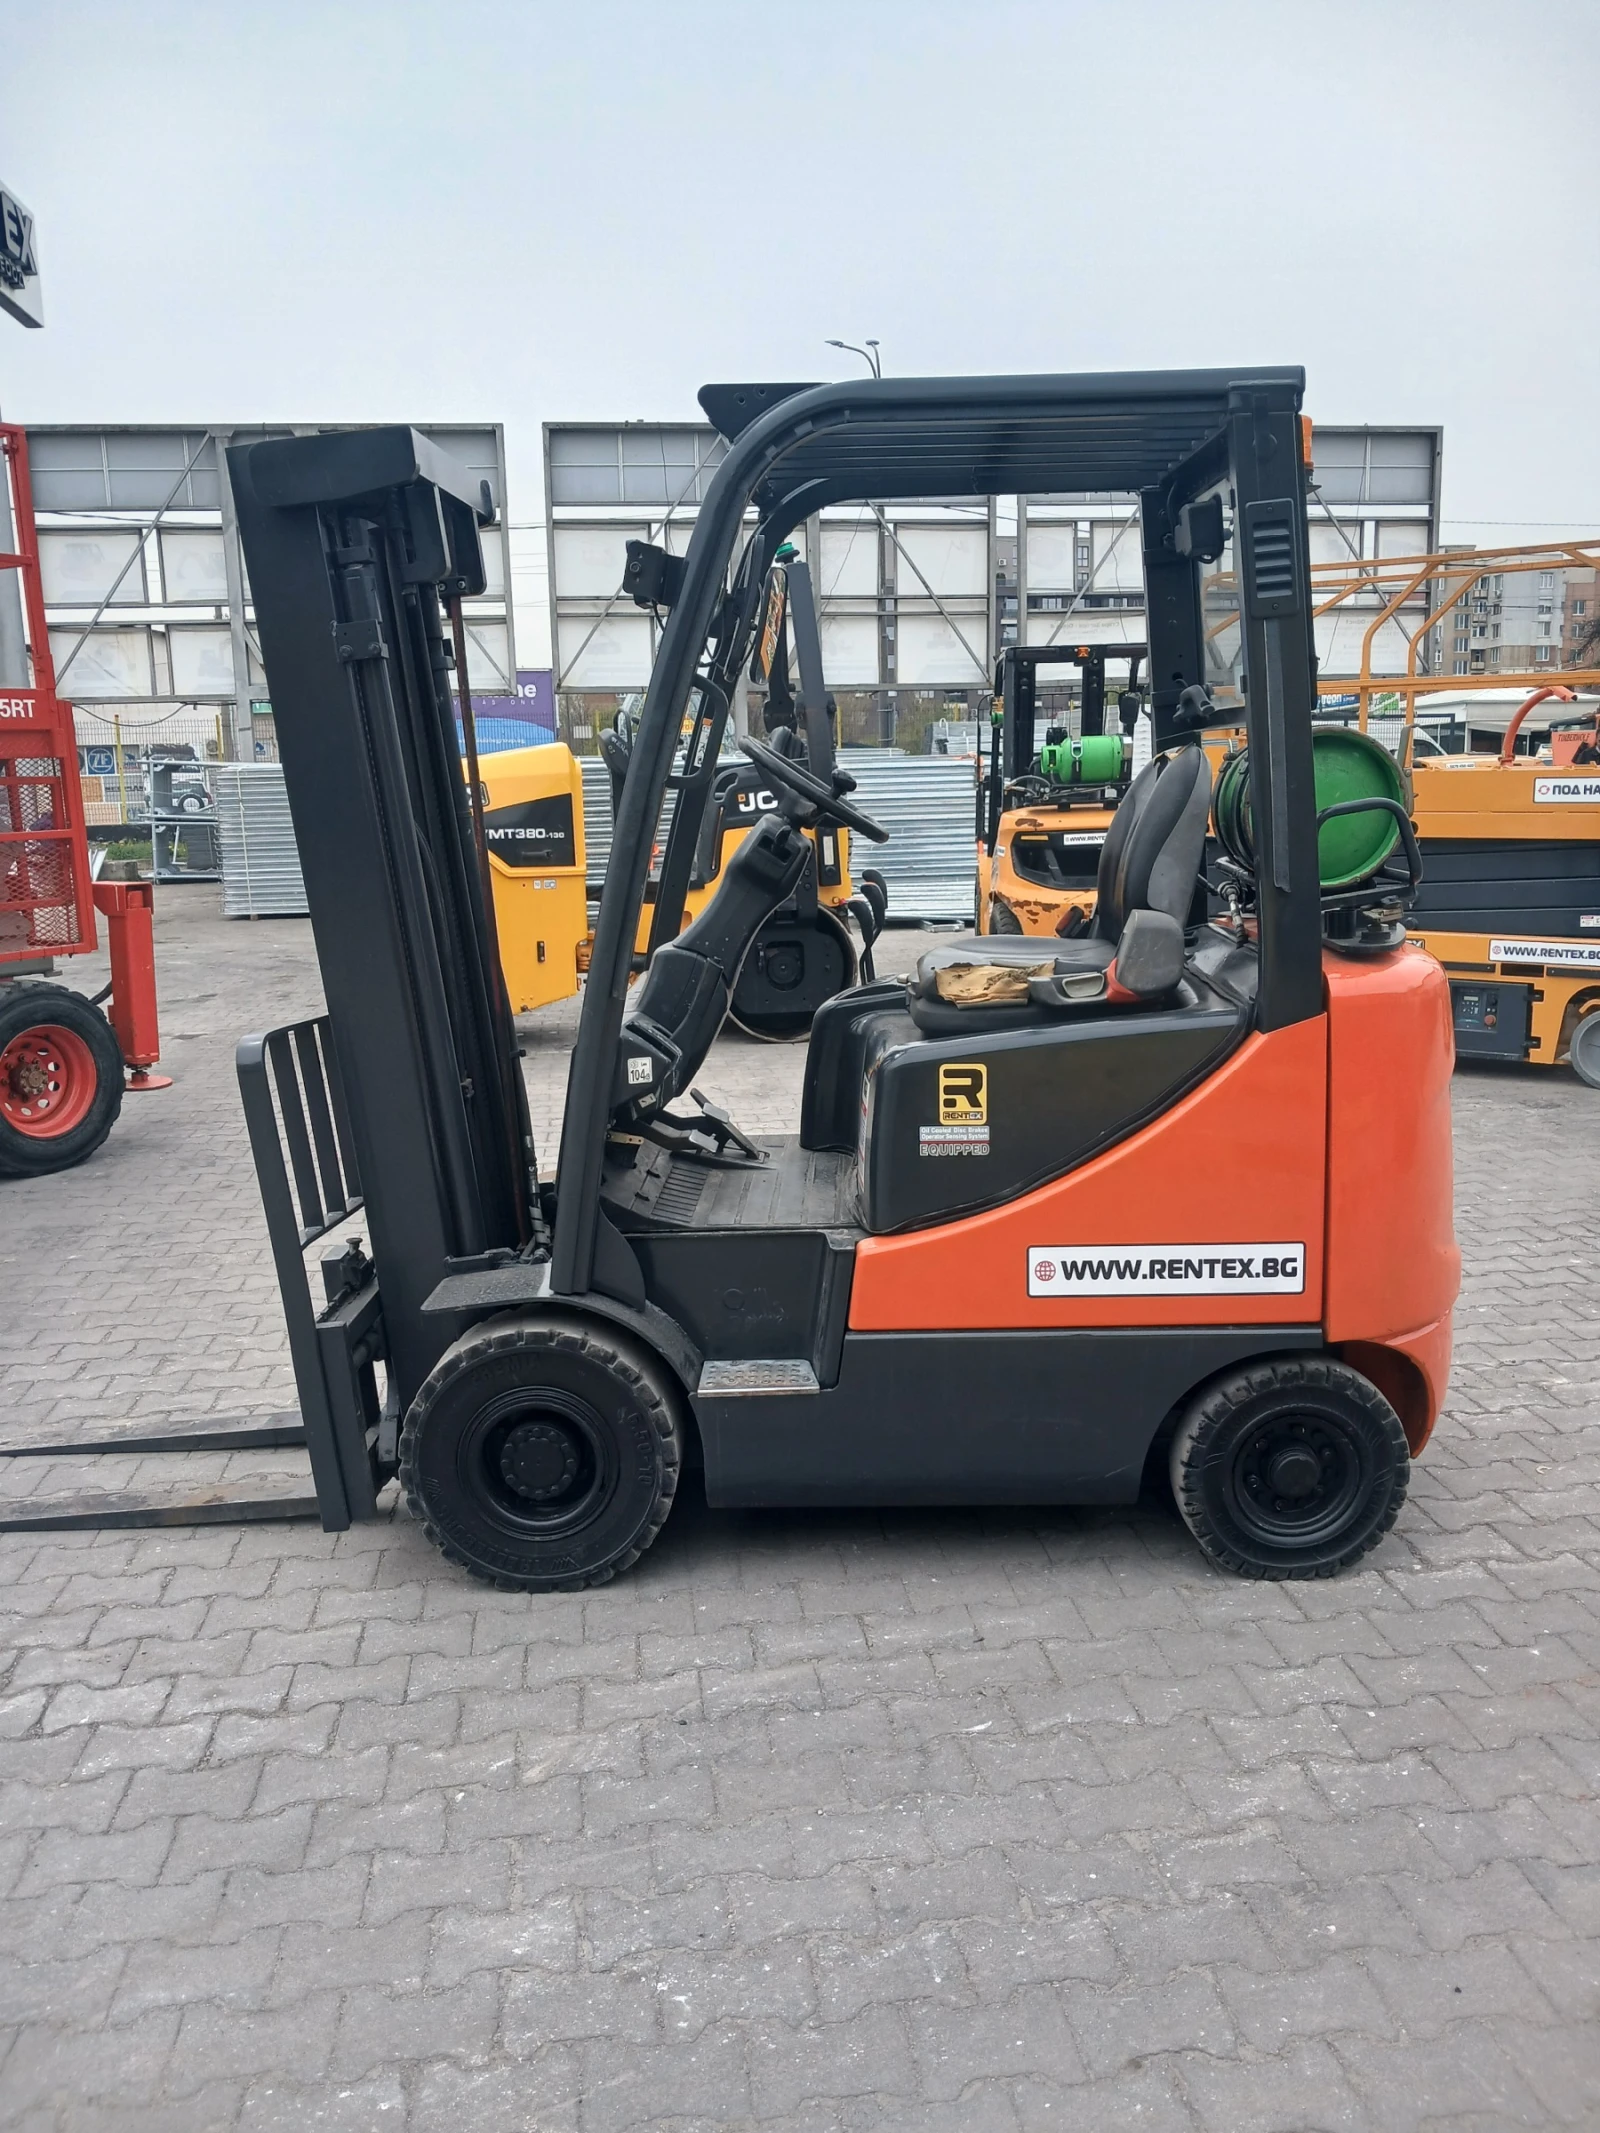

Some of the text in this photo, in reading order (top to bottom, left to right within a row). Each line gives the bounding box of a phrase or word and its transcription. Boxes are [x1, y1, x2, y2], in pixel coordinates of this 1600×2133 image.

[0, 698, 36, 718] 5RT
[1552, 785, 1581, 796] ПОД
[485, 828, 565, 839] MT380-130
[630, 1069, 646, 1082] 104
[920, 1143, 989, 1156] EQUIPPED
[1060, 1257, 1298, 1281] WWW.RENTEX.BG
